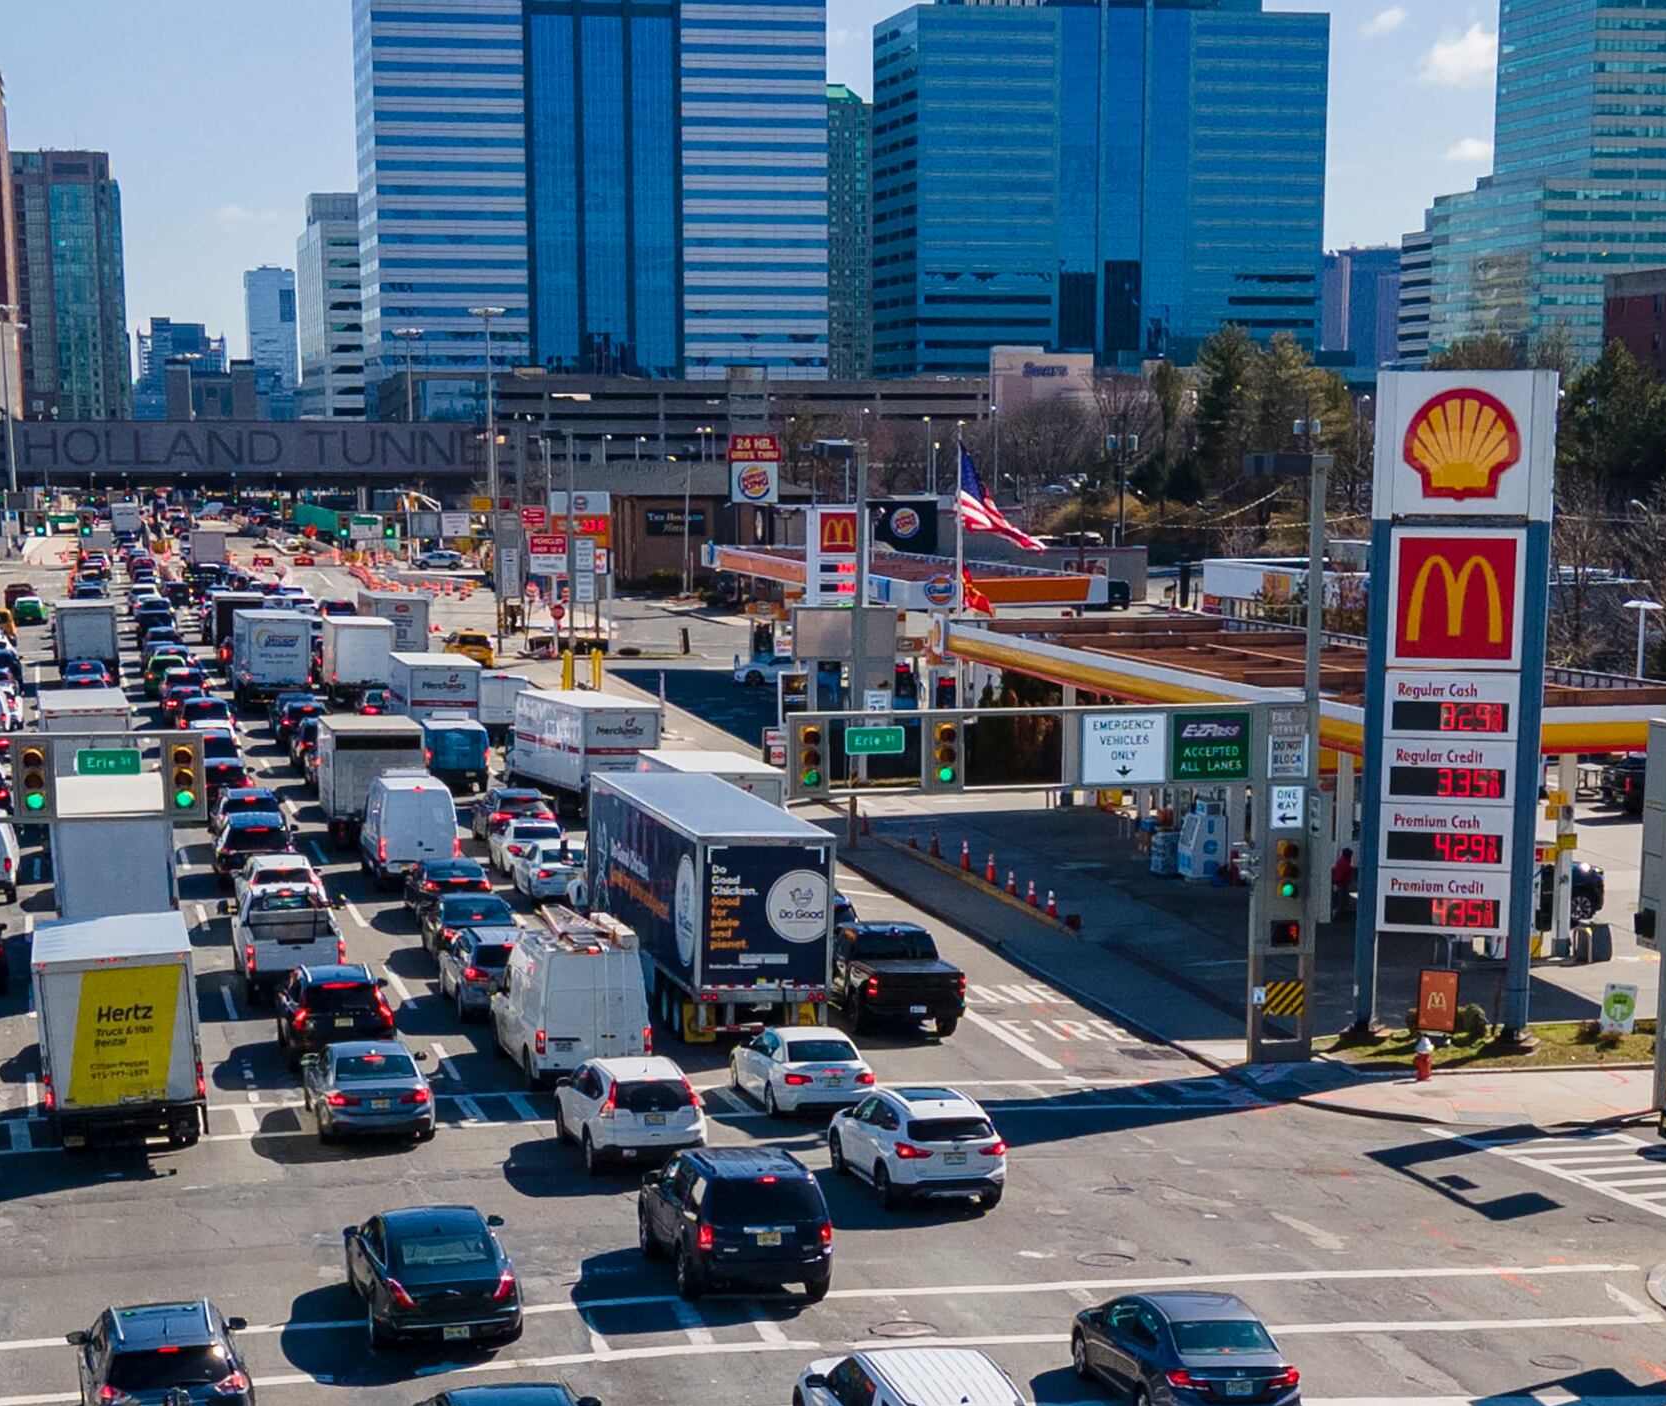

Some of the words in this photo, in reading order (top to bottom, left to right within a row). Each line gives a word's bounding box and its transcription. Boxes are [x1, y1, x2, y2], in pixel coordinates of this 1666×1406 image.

[22, 429, 282, 466] HOLLAND
[927, 585, 953, 594] Gulf
[1397, 682, 1445, 699] Regular
[1449, 683, 1478, 698] Cash
[1093, 720, 1155, 731] EMERGENCY
[854, 735, 881, 746] Erie
[1100, 735, 1150, 745] VEHICLES
[1111, 750, 1137, 760] ONLY
[1183, 747, 1239, 757] ACCEPTED
[1396, 748, 1443, 765] Regular
[1447, 748, 1483, 764] Credit
[86, 757, 116, 768] Erie
[1273, 754, 1302, 764] BLOCK
[1180, 762, 1200, 772] ALL
[1207, 760, 1242, 771] LANES
[1277, 789, 1298, 799] ONE
[1278, 802, 1298, 810] WAY
[1394, 813, 1447, 828] Premium
[1451, 815, 1480, 829] Cash
[712, 865, 727, 874] Do
[711, 875, 741, 885] Good
[711, 886, 759, 896] Chicken.
[1391, 878, 1444, 892] Premium
[1448, 880, 1484, 894] Credit
[711, 897, 740, 906] Good
[711, 908, 729, 917] for
[779, 909, 793, 919] Do
[795, 909, 824, 919] Good
[711, 919, 740, 929] plate
[711, 929, 732, 938] and
[965, 984, 1075, 1004] ANE
[97, 1003, 153, 1023] Hertz
[96, 1028, 124, 1037] Truck
[126, 1026, 133, 1034] &
[135, 1025, 153, 1034] Van
[997, 1019, 1144, 1043] FIRE
[94, 1038, 127, 1048] Rental
